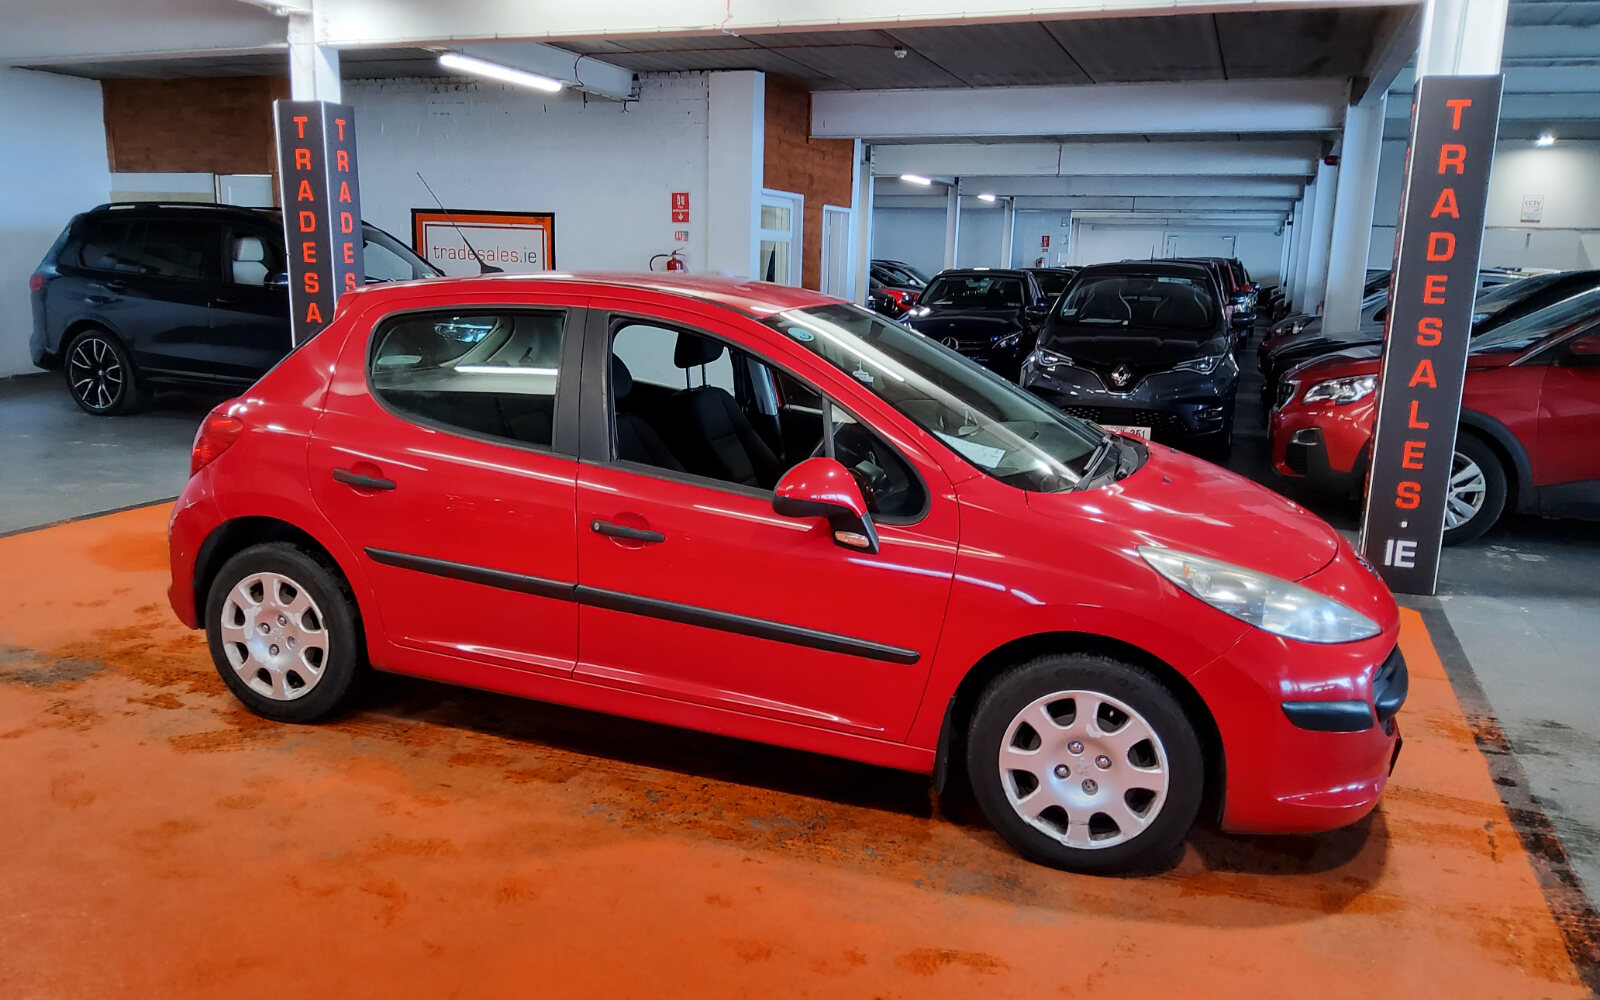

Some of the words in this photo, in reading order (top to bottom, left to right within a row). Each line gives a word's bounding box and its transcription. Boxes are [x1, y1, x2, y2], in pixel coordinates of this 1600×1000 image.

[293, 116, 323, 324] TRADESA
[334, 118, 356, 293] TRADES
[433, 244, 537, 264] tradesales.ie
